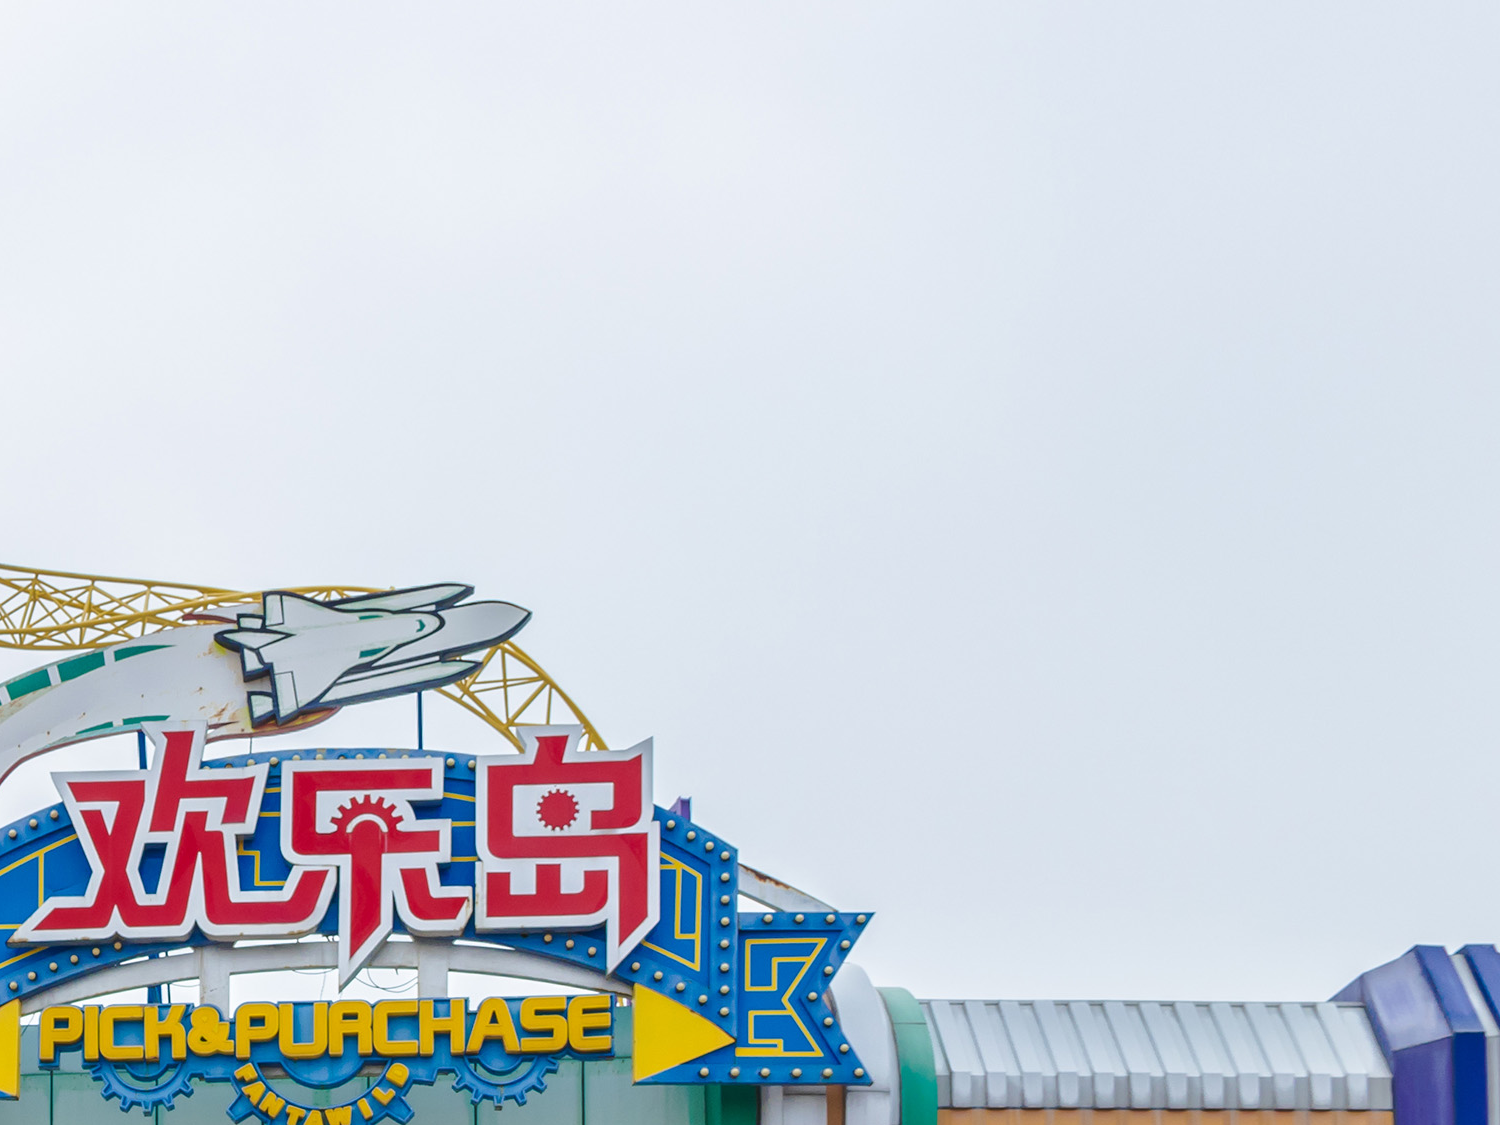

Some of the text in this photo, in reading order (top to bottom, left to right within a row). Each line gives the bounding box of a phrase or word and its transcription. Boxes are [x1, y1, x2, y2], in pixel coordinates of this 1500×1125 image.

[10, 721, 660, 990] 欢乐岛
[38, 994, 613, 1063] PICK&PURCHASE
